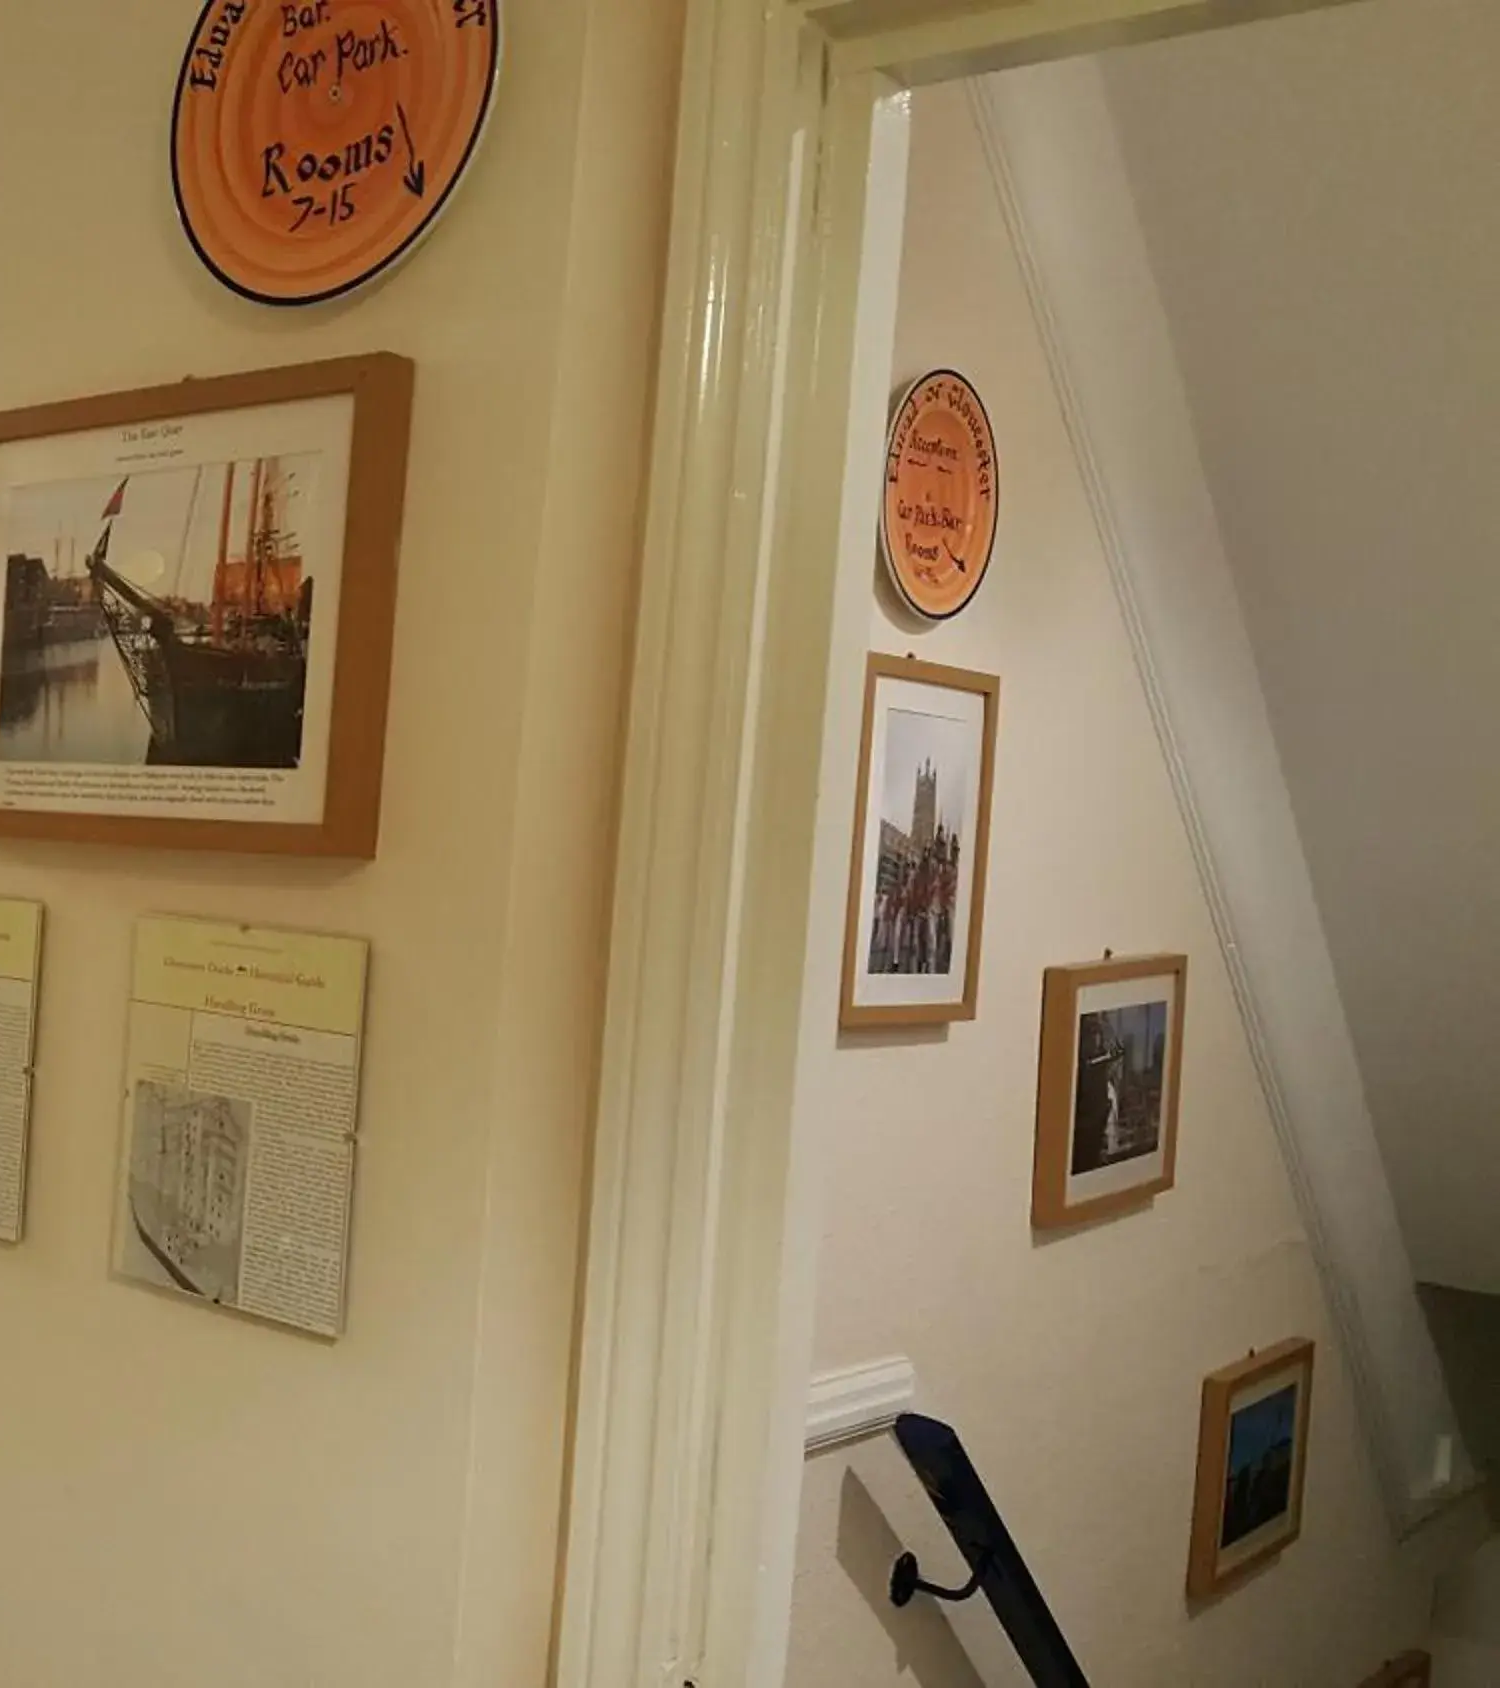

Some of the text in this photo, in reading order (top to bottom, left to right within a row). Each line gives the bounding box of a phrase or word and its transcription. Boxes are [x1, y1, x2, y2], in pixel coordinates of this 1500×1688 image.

[281, 0, 331, 37] Bar.
[277, 20, 409, 94] Car Park.
[261, 124, 395, 198] Rooms
[289, 183, 356, 233] 7-15
